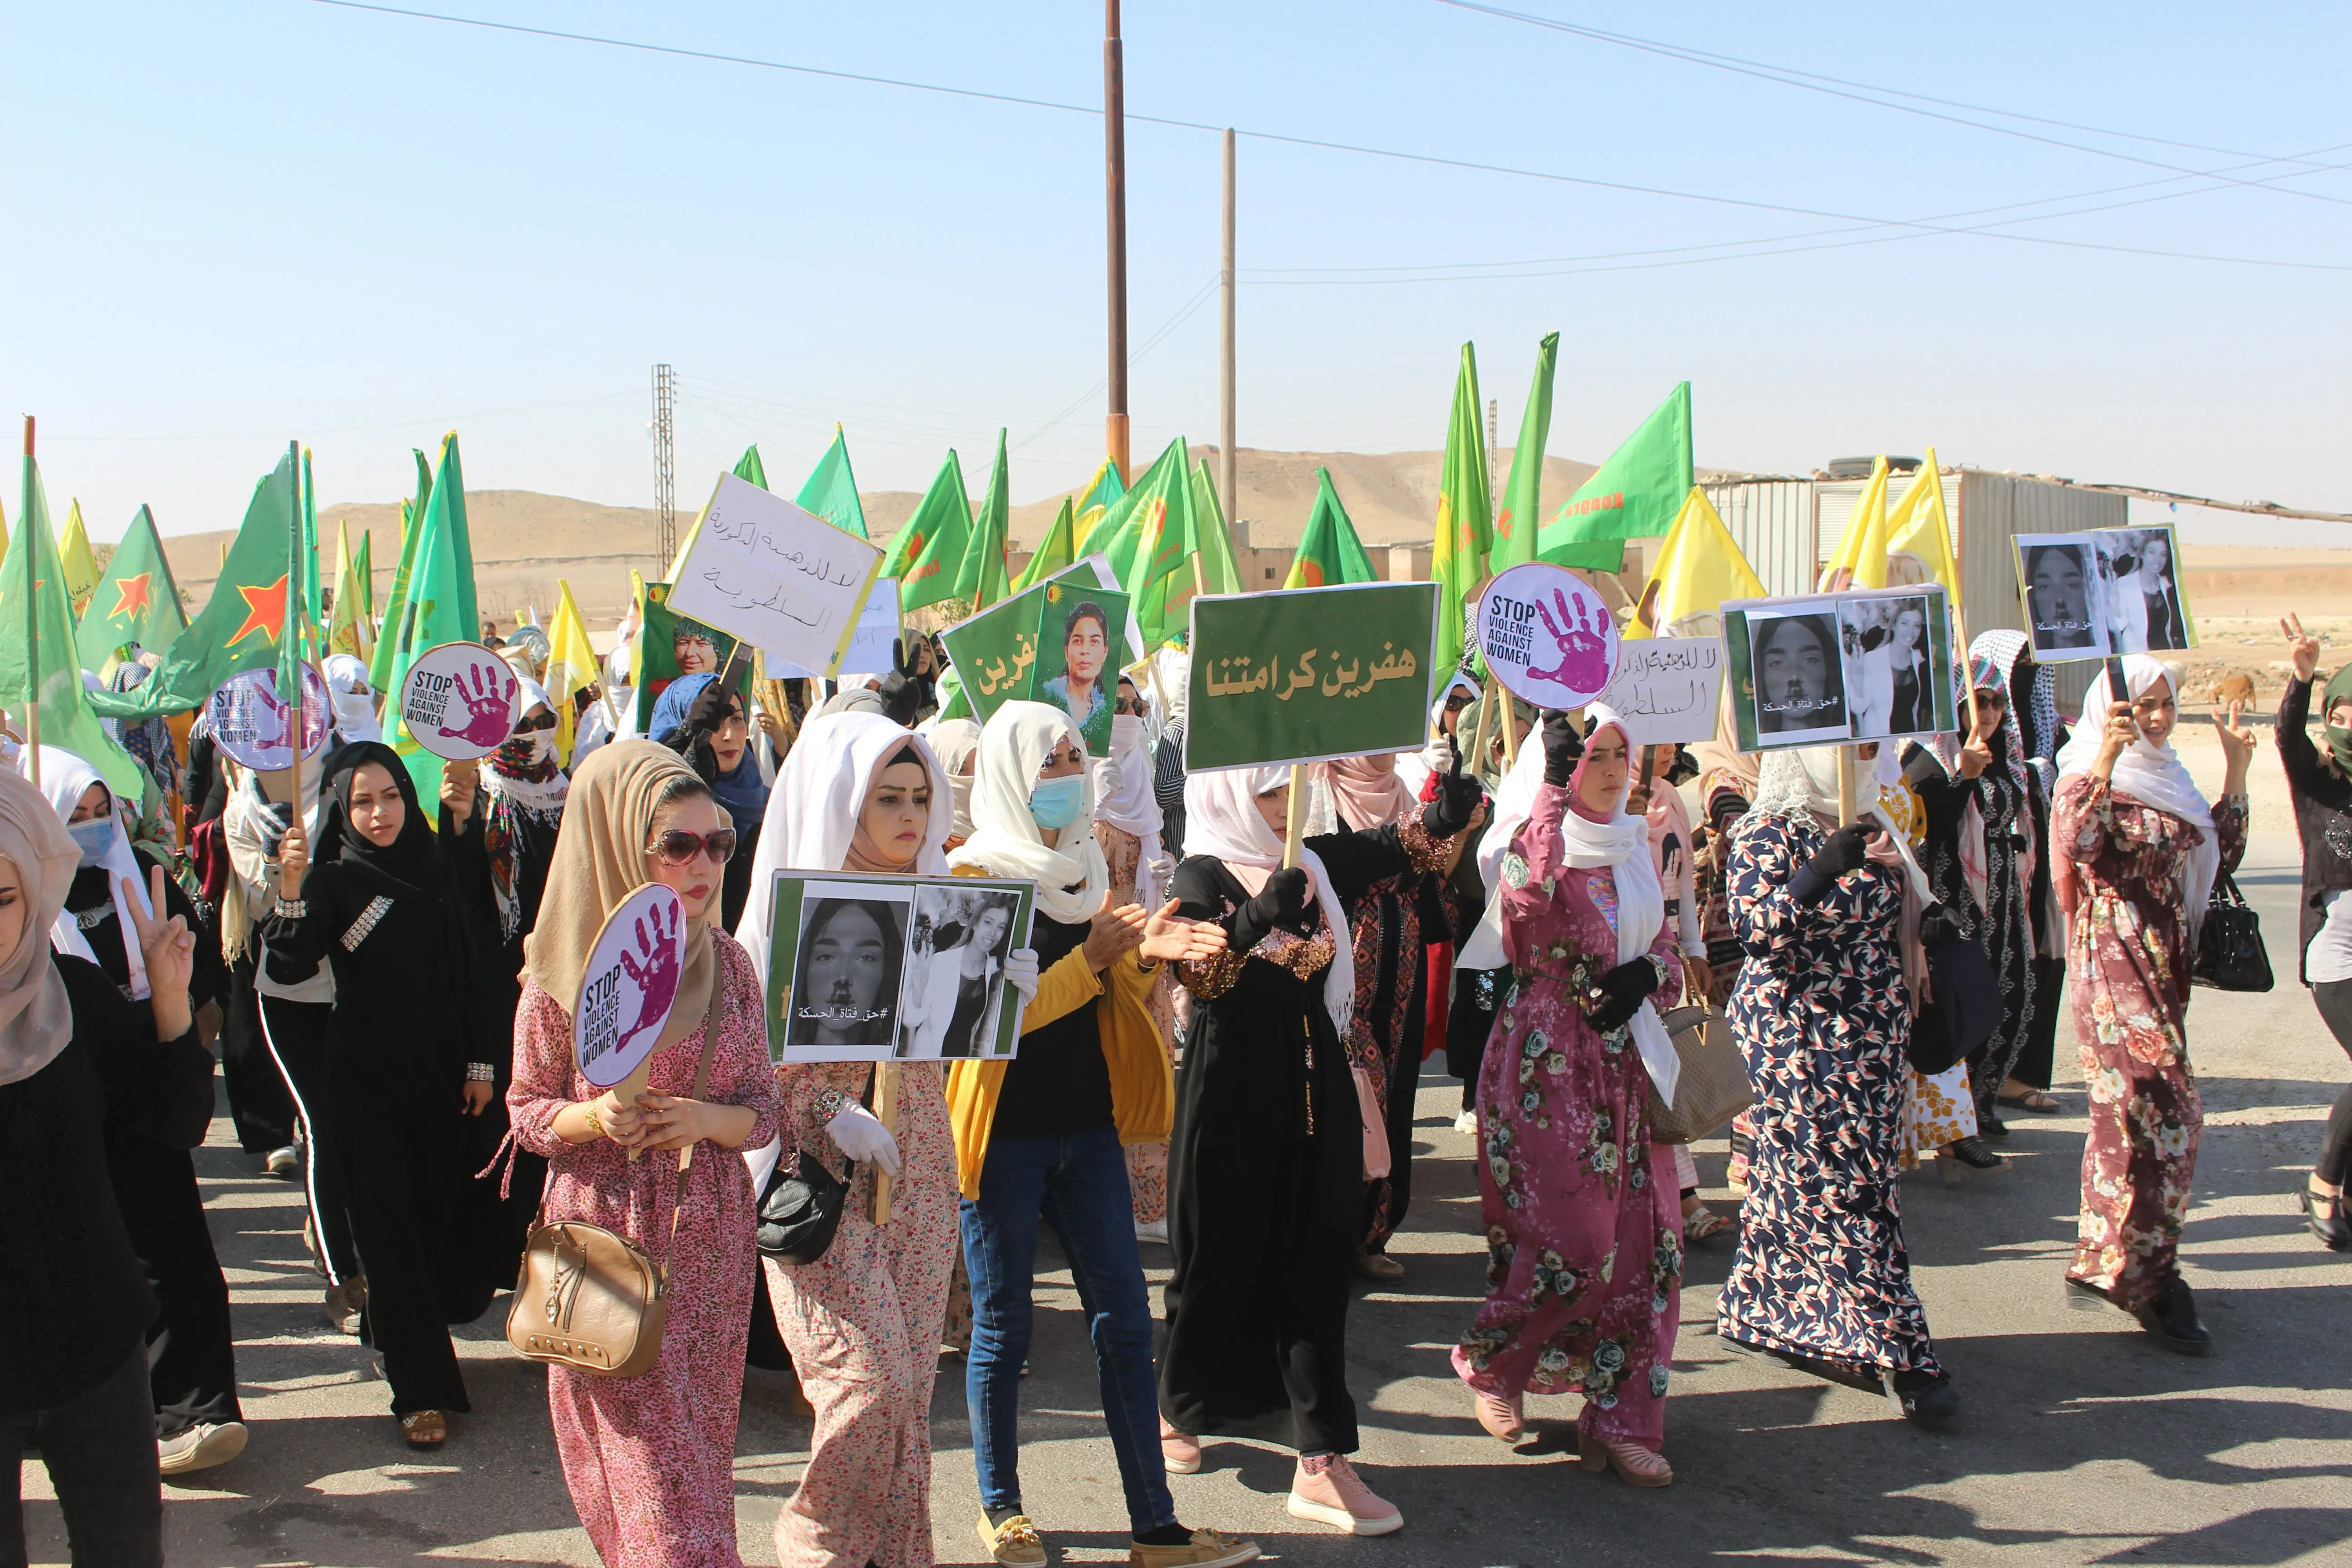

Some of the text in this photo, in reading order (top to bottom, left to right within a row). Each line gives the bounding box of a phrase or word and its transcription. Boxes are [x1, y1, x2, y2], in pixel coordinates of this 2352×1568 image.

[828, 570, 860, 587] لا
[703, 567, 833, 634] السلطوية
[1491, 595, 1535, 624] STOP
[1490, 615, 1534, 638] VIOLENCE
[1488, 628, 1532, 651] AGAINST
[975, 633, 1038, 696] فرين
[1486, 642, 1530, 667] WOMEN
[1702, 647, 1715, 669] لا
[415, 671, 453, 693] STOP
[1206, 641, 1416, 701] هفرين كرامتنا
[409, 698, 446, 715] AGAINST
[412, 687, 450, 705] VIOLENCE
[407, 709, 444, 727] WOMEN
[585, 964, 621, 1013] STOP
[584, 990, 620, 1031] VIOLENCE
[583, 1007, 619, 1049] AGAINST
[583, 1024, 618, 1068] WOMEN
